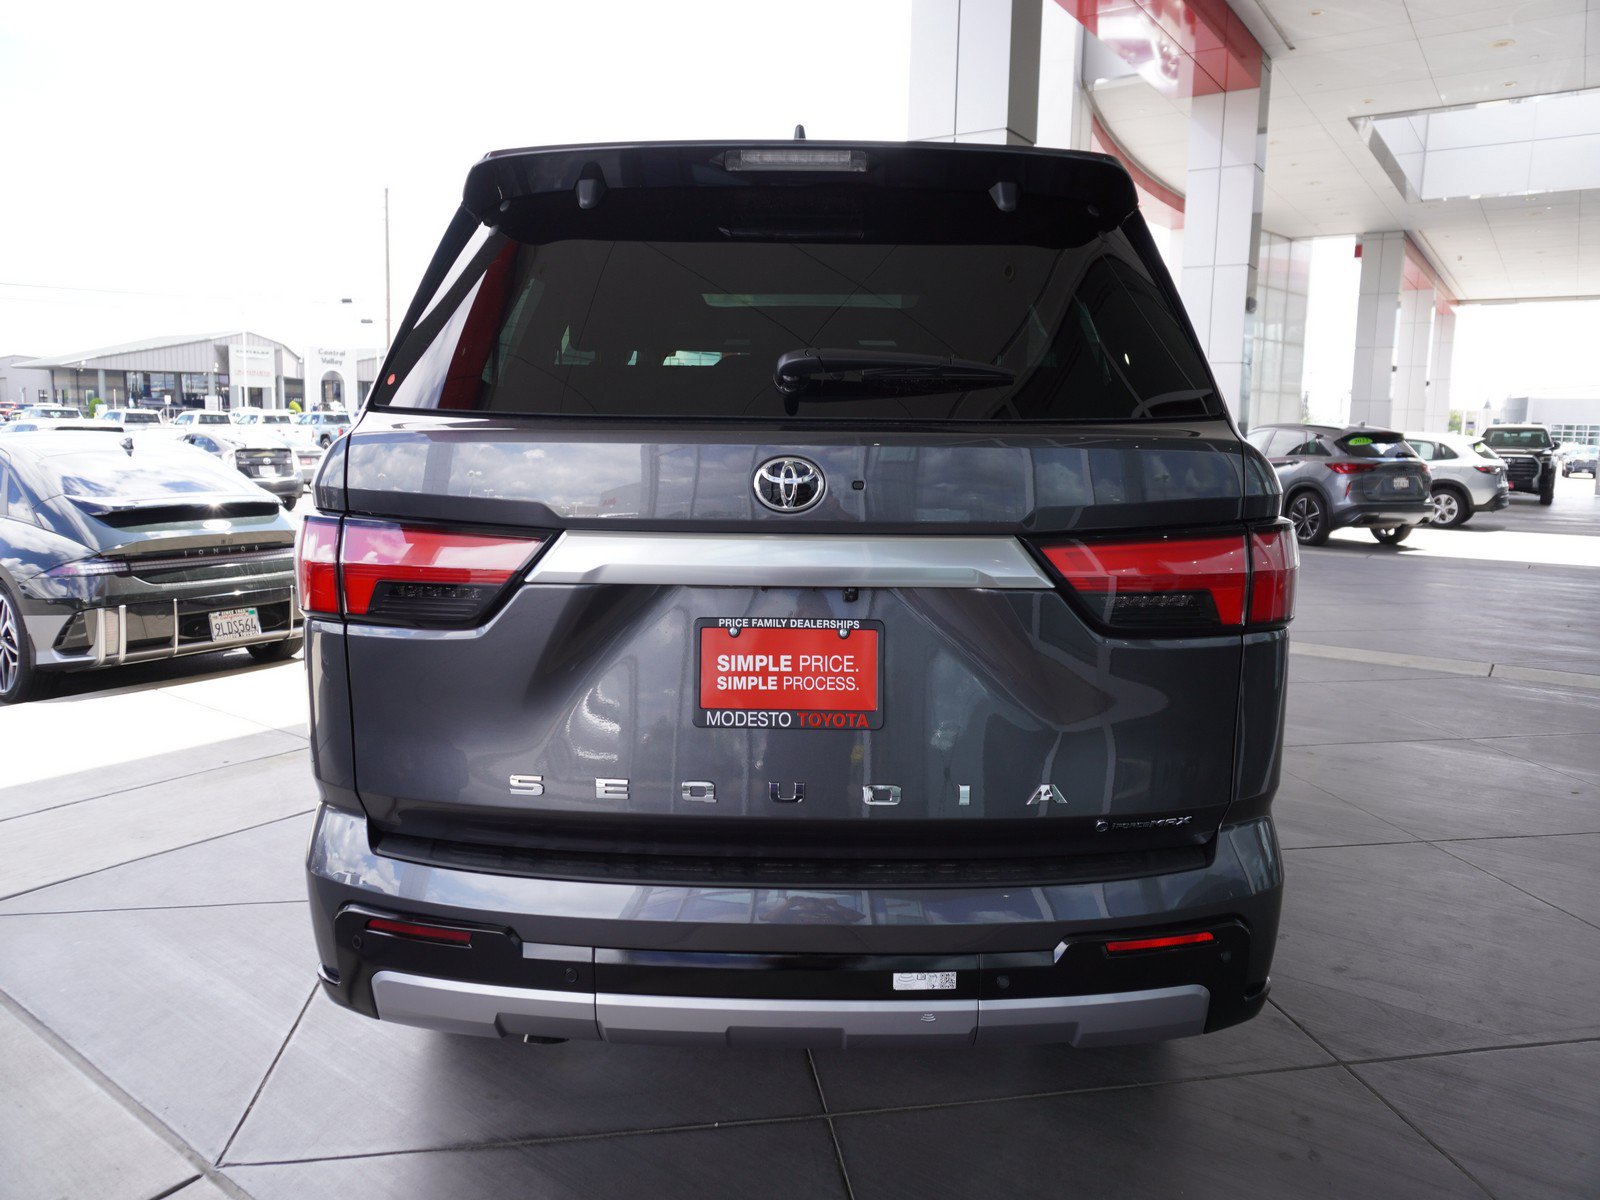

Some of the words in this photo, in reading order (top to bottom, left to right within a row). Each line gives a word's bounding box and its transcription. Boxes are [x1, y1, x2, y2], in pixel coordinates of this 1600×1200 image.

[318, 347, 346, 356] Central
[320, 357, 343, 367] Valley
[214, 617, 257, 638] 9LDS564
[718, 618, 749, 628] PRICE
[751, 619, 788, 628] FAMILY
[790, 619, 860, 629] DEALERSHIPS
[716, 654, 792, 673] SIMPLE
[798, 655, 859, 673] PRICE.
[716, 676, 778, 690] SIMPLE
[782, 676, 860, 691] PROCESS.
[706, 711, 792, 727] MODESTO
[797, 712, 869, 728] TOYOTA
[509, 774, 1069, 806] SEQUOIA
